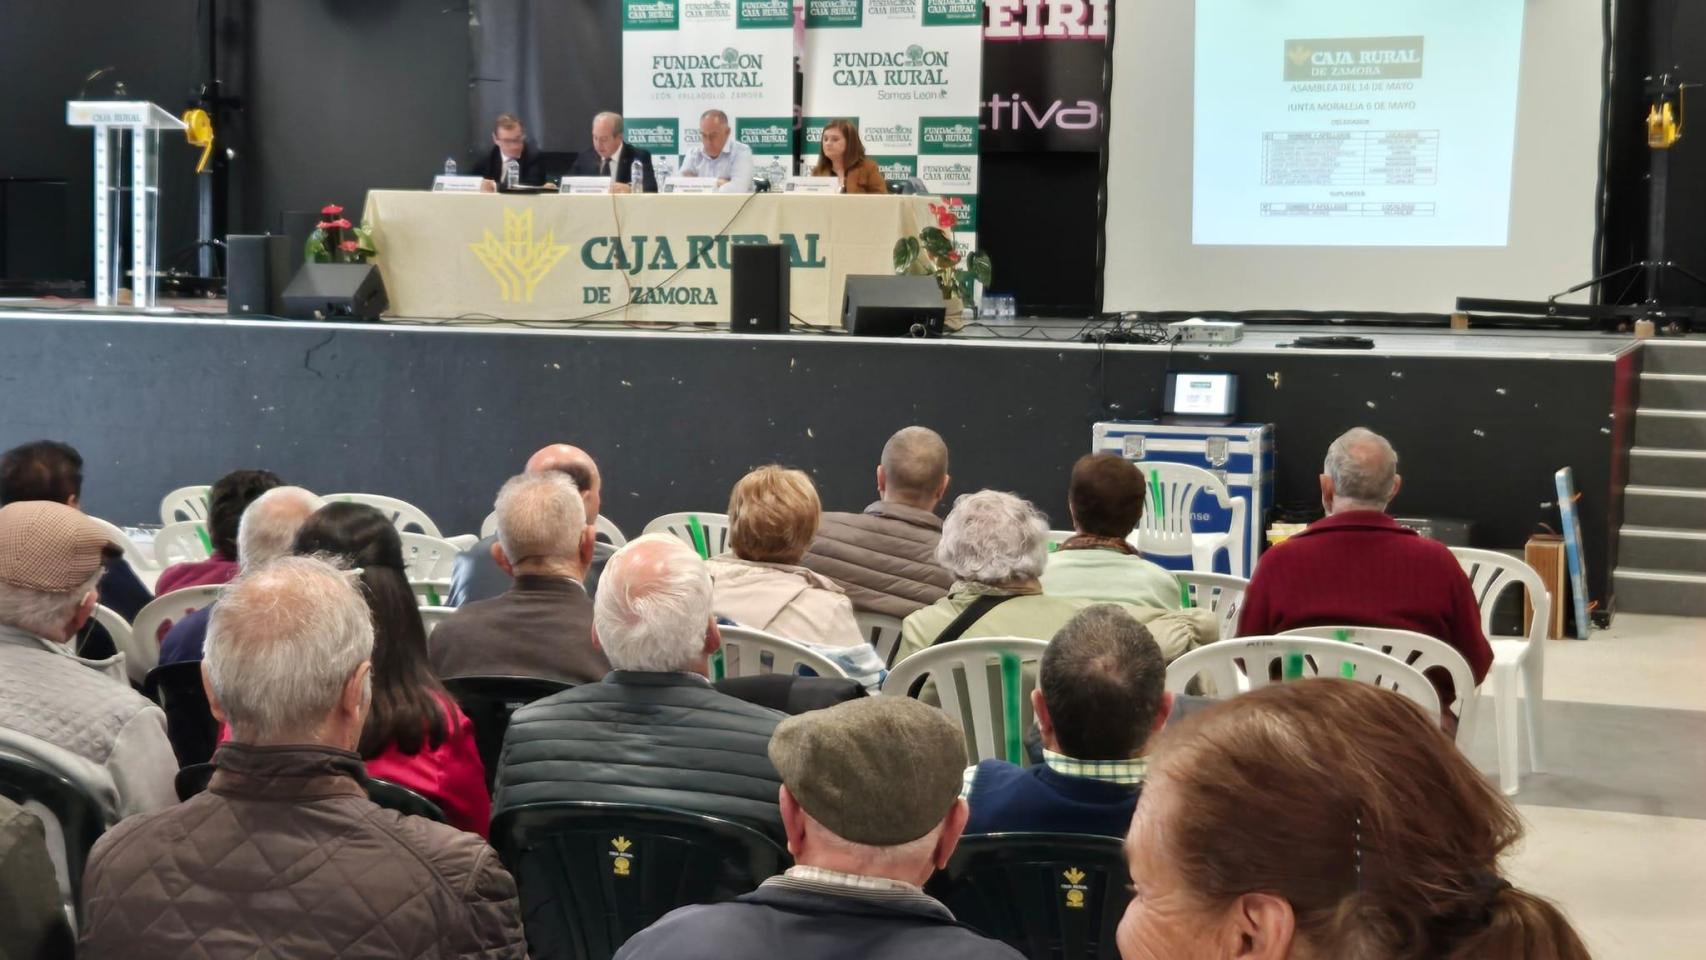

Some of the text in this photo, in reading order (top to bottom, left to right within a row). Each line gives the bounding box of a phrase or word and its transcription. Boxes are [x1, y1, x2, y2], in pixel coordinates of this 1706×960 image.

[1311, 49, 1421, 65] CAJA RURAL
[833, 69, 949, 87] CAJA RURAL
[1312, 66, 1381, 76] DE ZAMORA
[652, 72, 764, 89] CAJA RURAL
[1290, 82, 1338, 92] ASAMBLEA
[1340, 82, 1356, 92] DEL
[1372, 82, 1384, 91] DE
[1386, 81, 1414, 91] MAYO
[878, 90, 911, 100] Somos
[979, 93, 1098, 130] tiva
[1374, 101, 1386, 110] DE
[1388, 100, 1416, 110] MAYO
[581, 235, 677, 275] CAJA
[582, 286, 718, 305] DE ZAMORA
